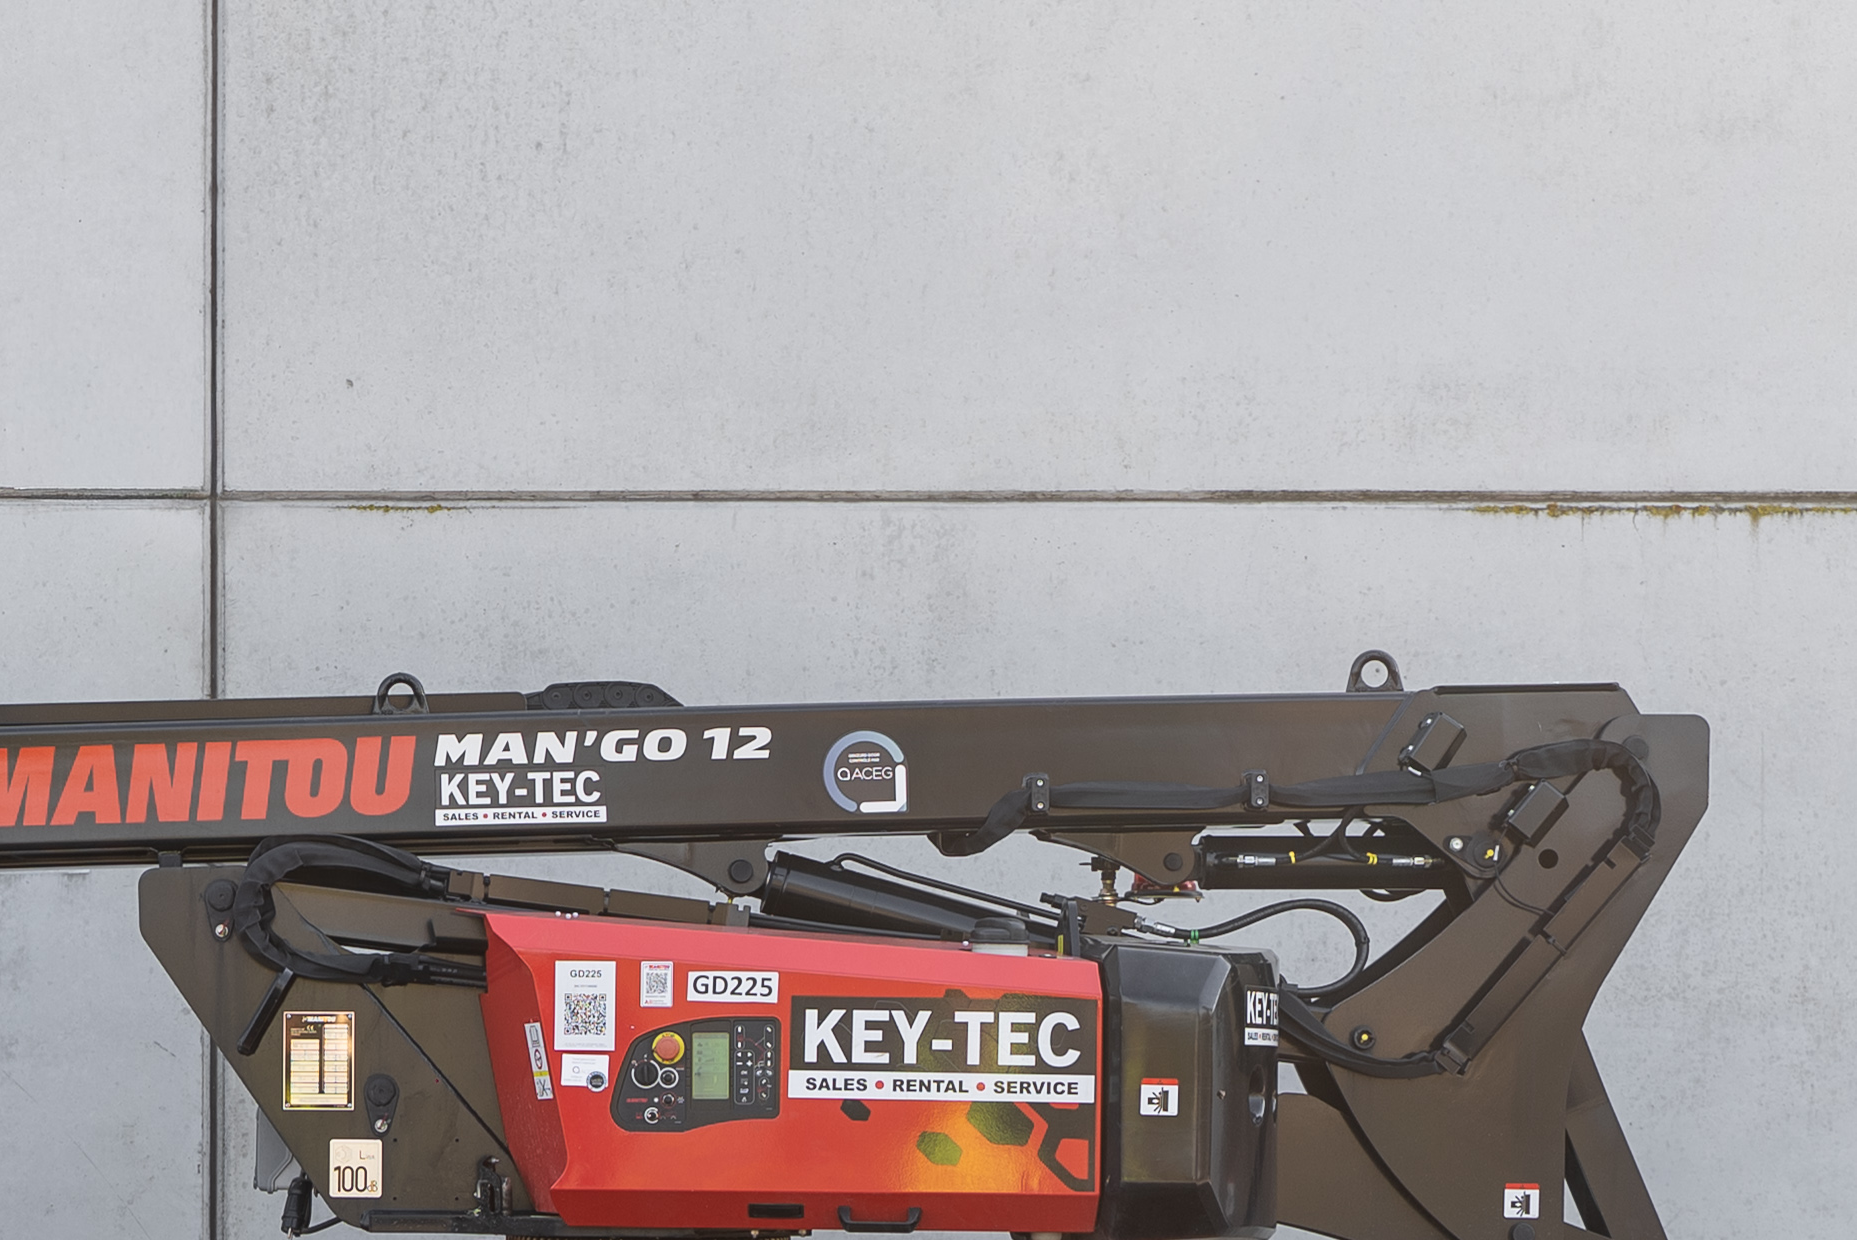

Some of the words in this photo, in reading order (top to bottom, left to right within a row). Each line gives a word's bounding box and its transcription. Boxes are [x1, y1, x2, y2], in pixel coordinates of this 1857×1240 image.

[433, 728, 687, 767] MAN'GO
[702, 726, 772, 760] 12
[440, 770, 602, 806] KEY-TEC
[443, 813, 479, 821] SALES
[493, 811, 537, 820] RENTAL
[551, 810, 600, 819] SERVICE
[569, 969, 603, 978] GD225
[693, 975, 773, 998] GD225
[1246, 990, 1279, 1026] KEY-TE
[803, 1009, 1081, 1067] KEY-TEC
[805, 1077, 868, 1092] SALES
[892, 1079, 969, 1093] RENTAL
[993, 1080, 1079, 1095] SERVICE
